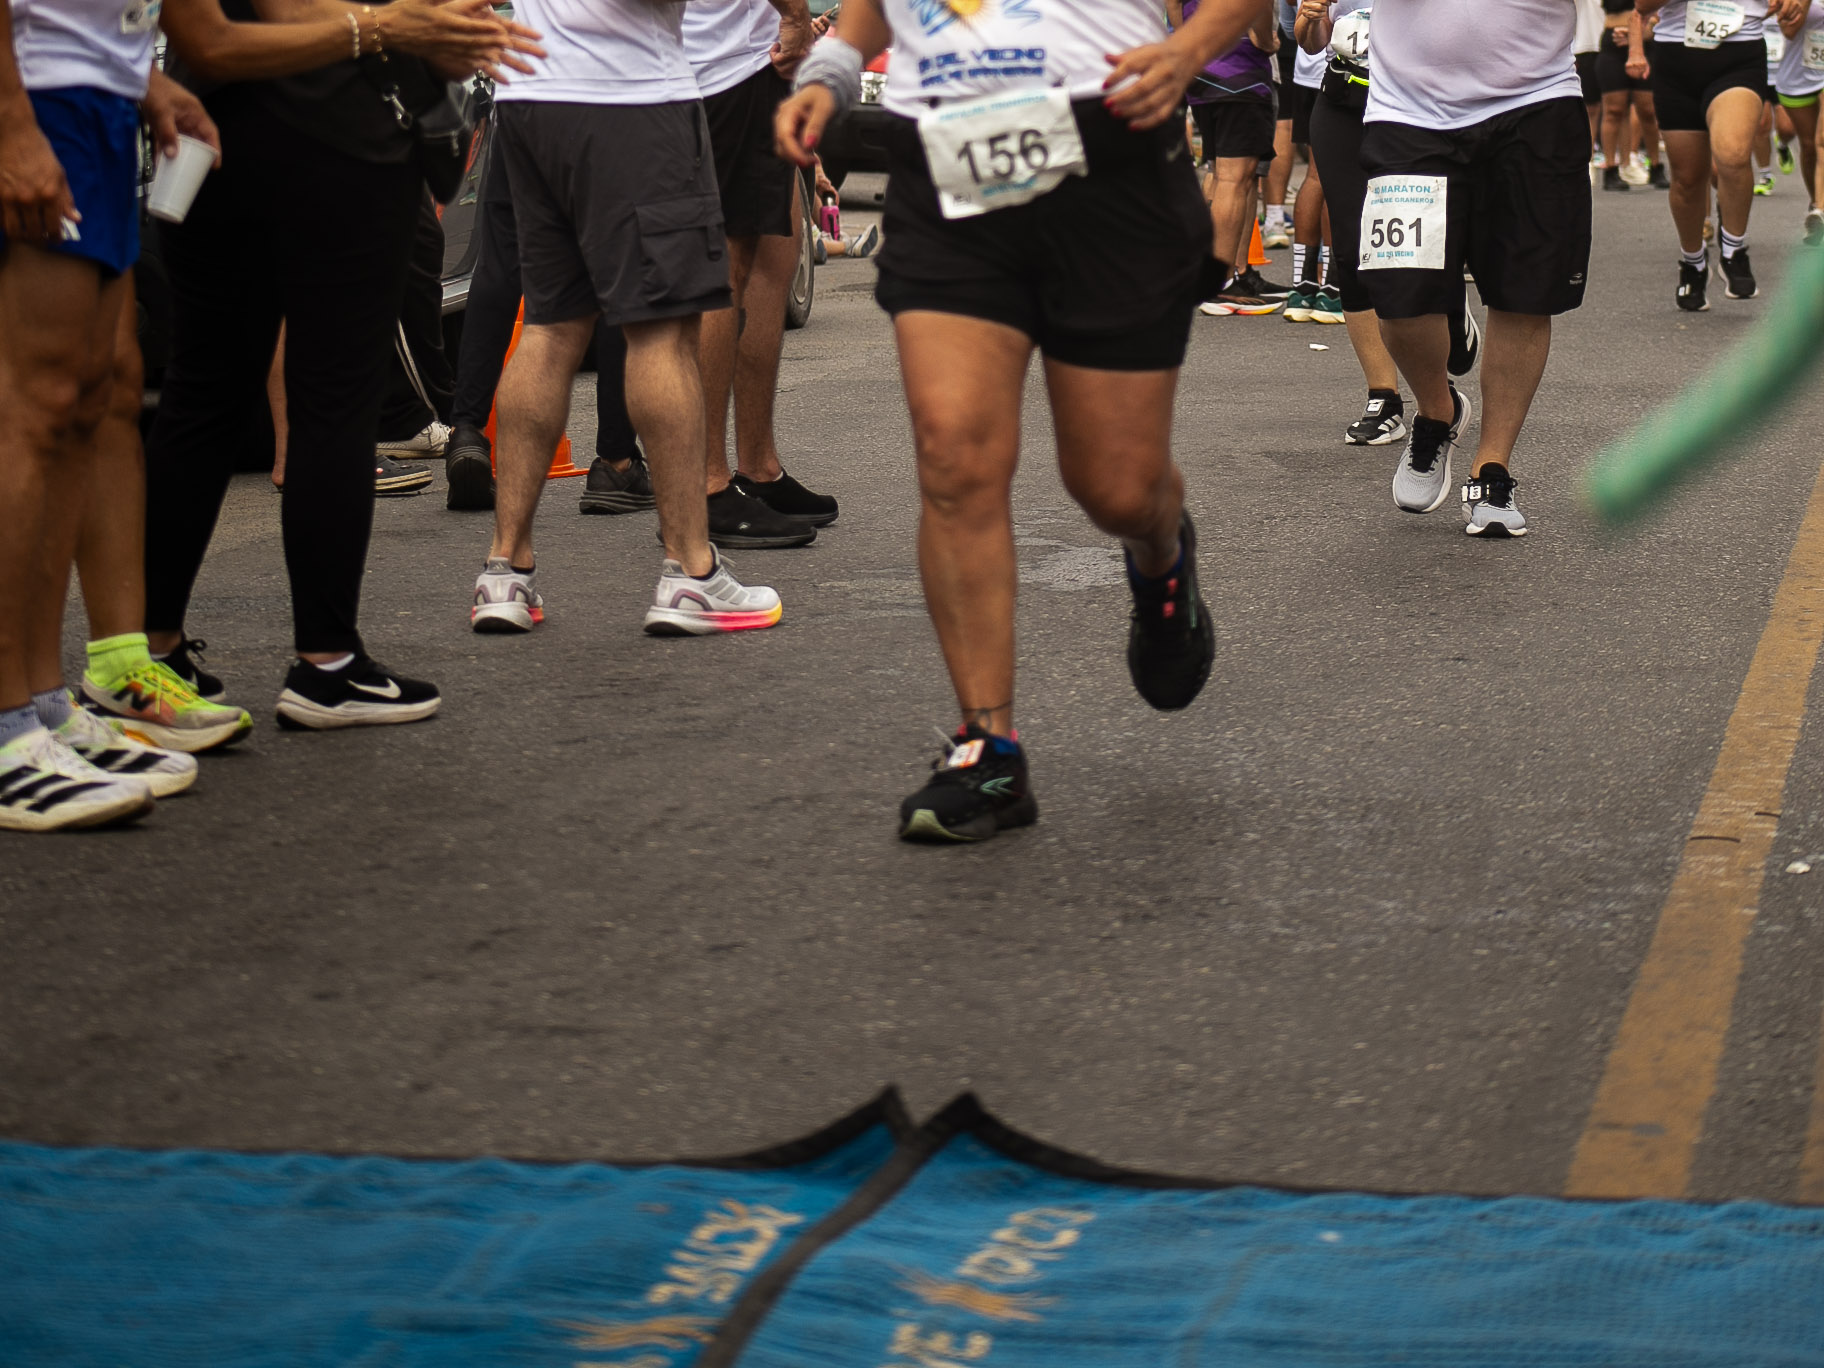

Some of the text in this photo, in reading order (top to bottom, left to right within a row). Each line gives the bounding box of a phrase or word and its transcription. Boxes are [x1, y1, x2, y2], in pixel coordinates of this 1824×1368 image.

[1695, 20, 1730, 39] 425
[957, 129, 1049, 185] 156
[1381, 185, 1431, 193] MARATON
[1370, 217, 1422, 248] 561
